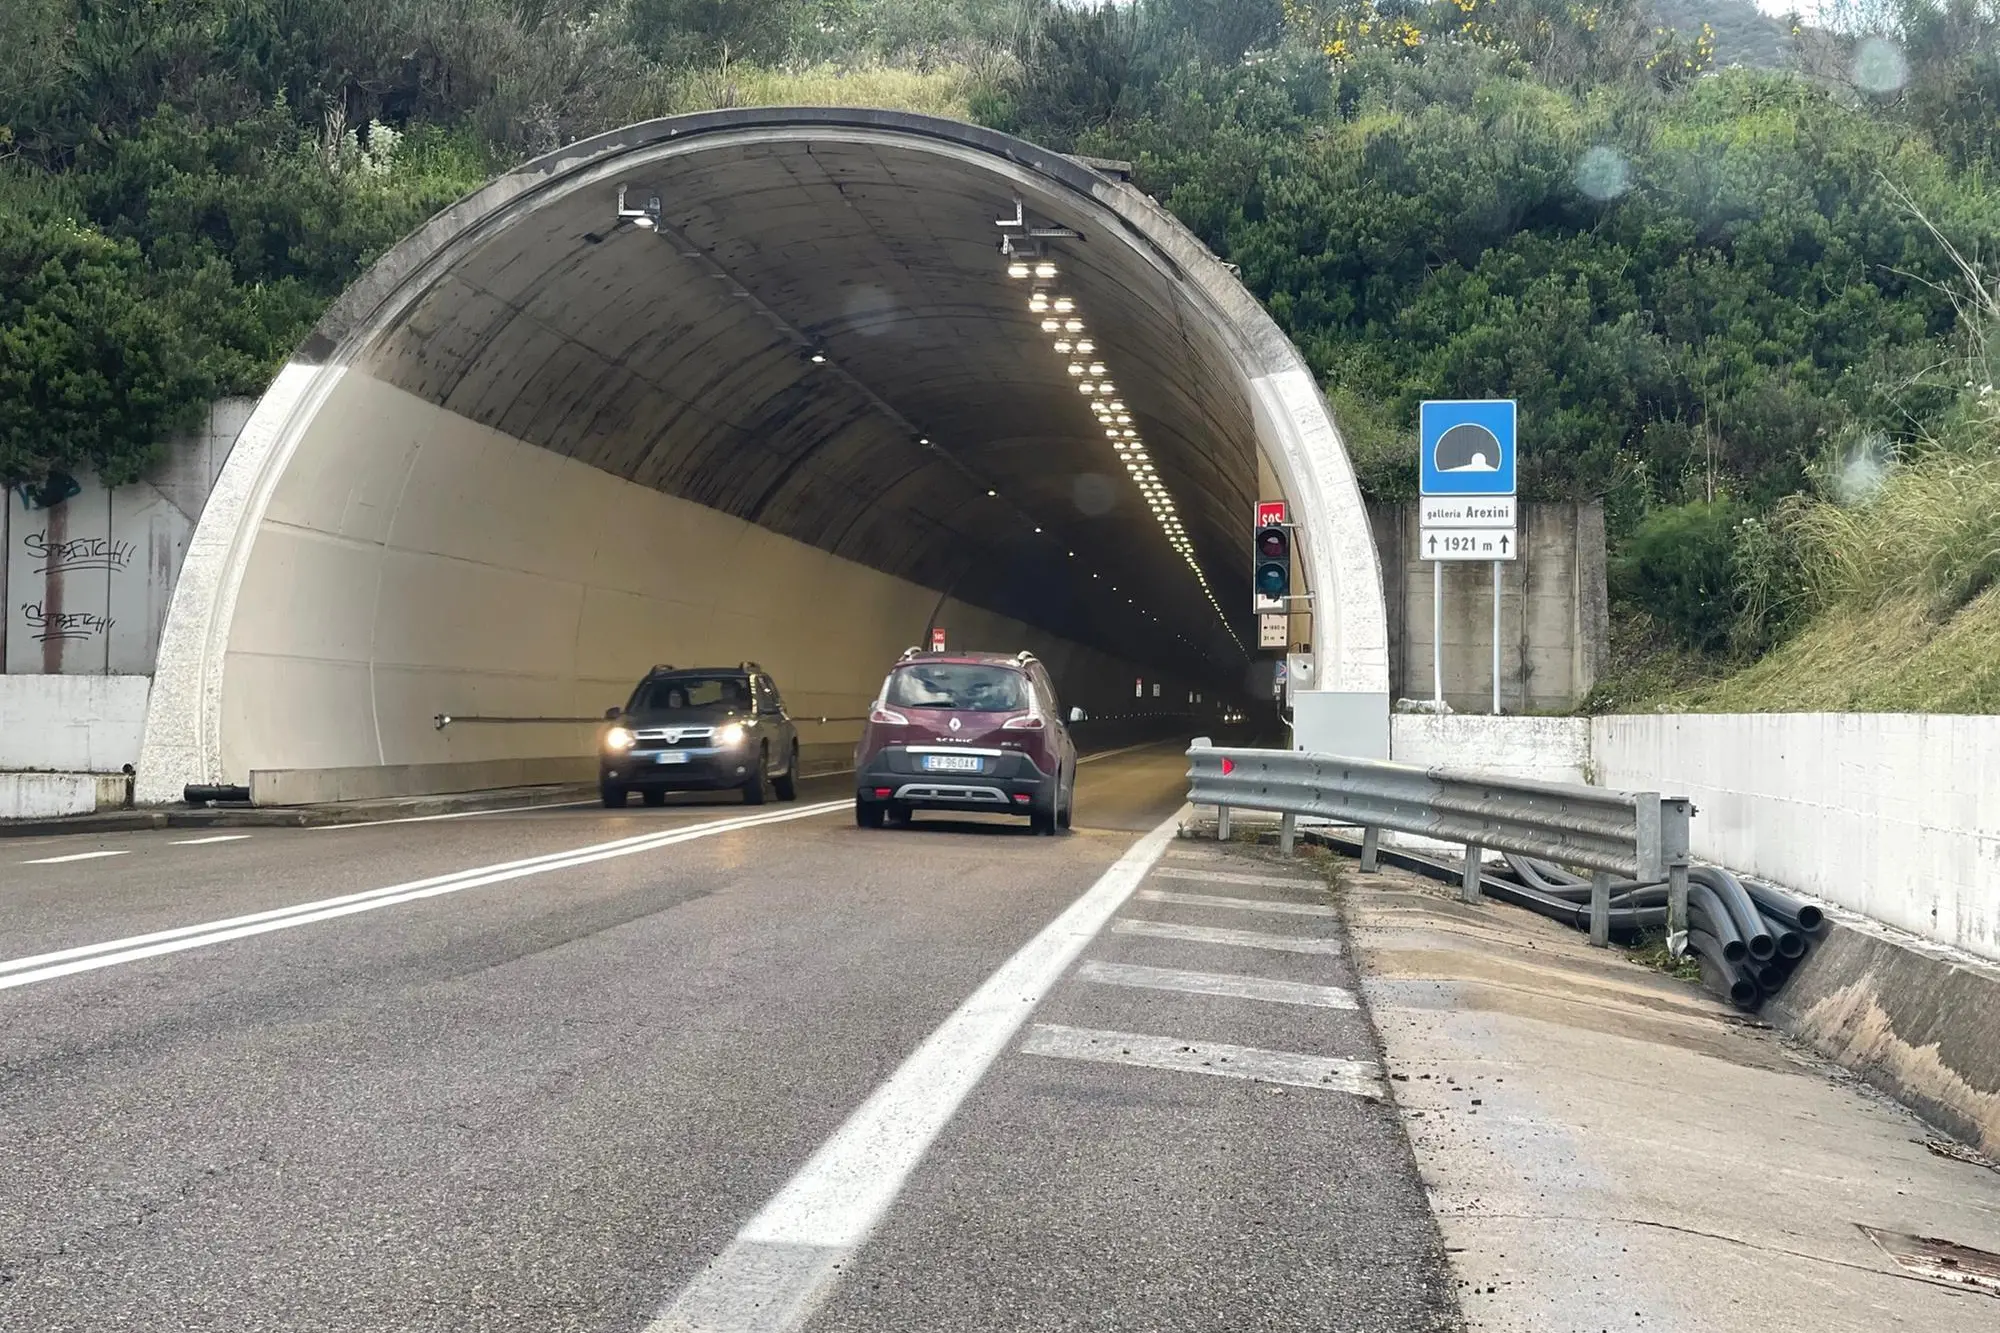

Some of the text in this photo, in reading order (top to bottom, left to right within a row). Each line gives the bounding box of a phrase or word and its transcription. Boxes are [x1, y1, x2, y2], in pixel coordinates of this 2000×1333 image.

[1427, 506, 1509, 520] galleria Arexini
[1444, 537, 1493, 551] 1921 m
